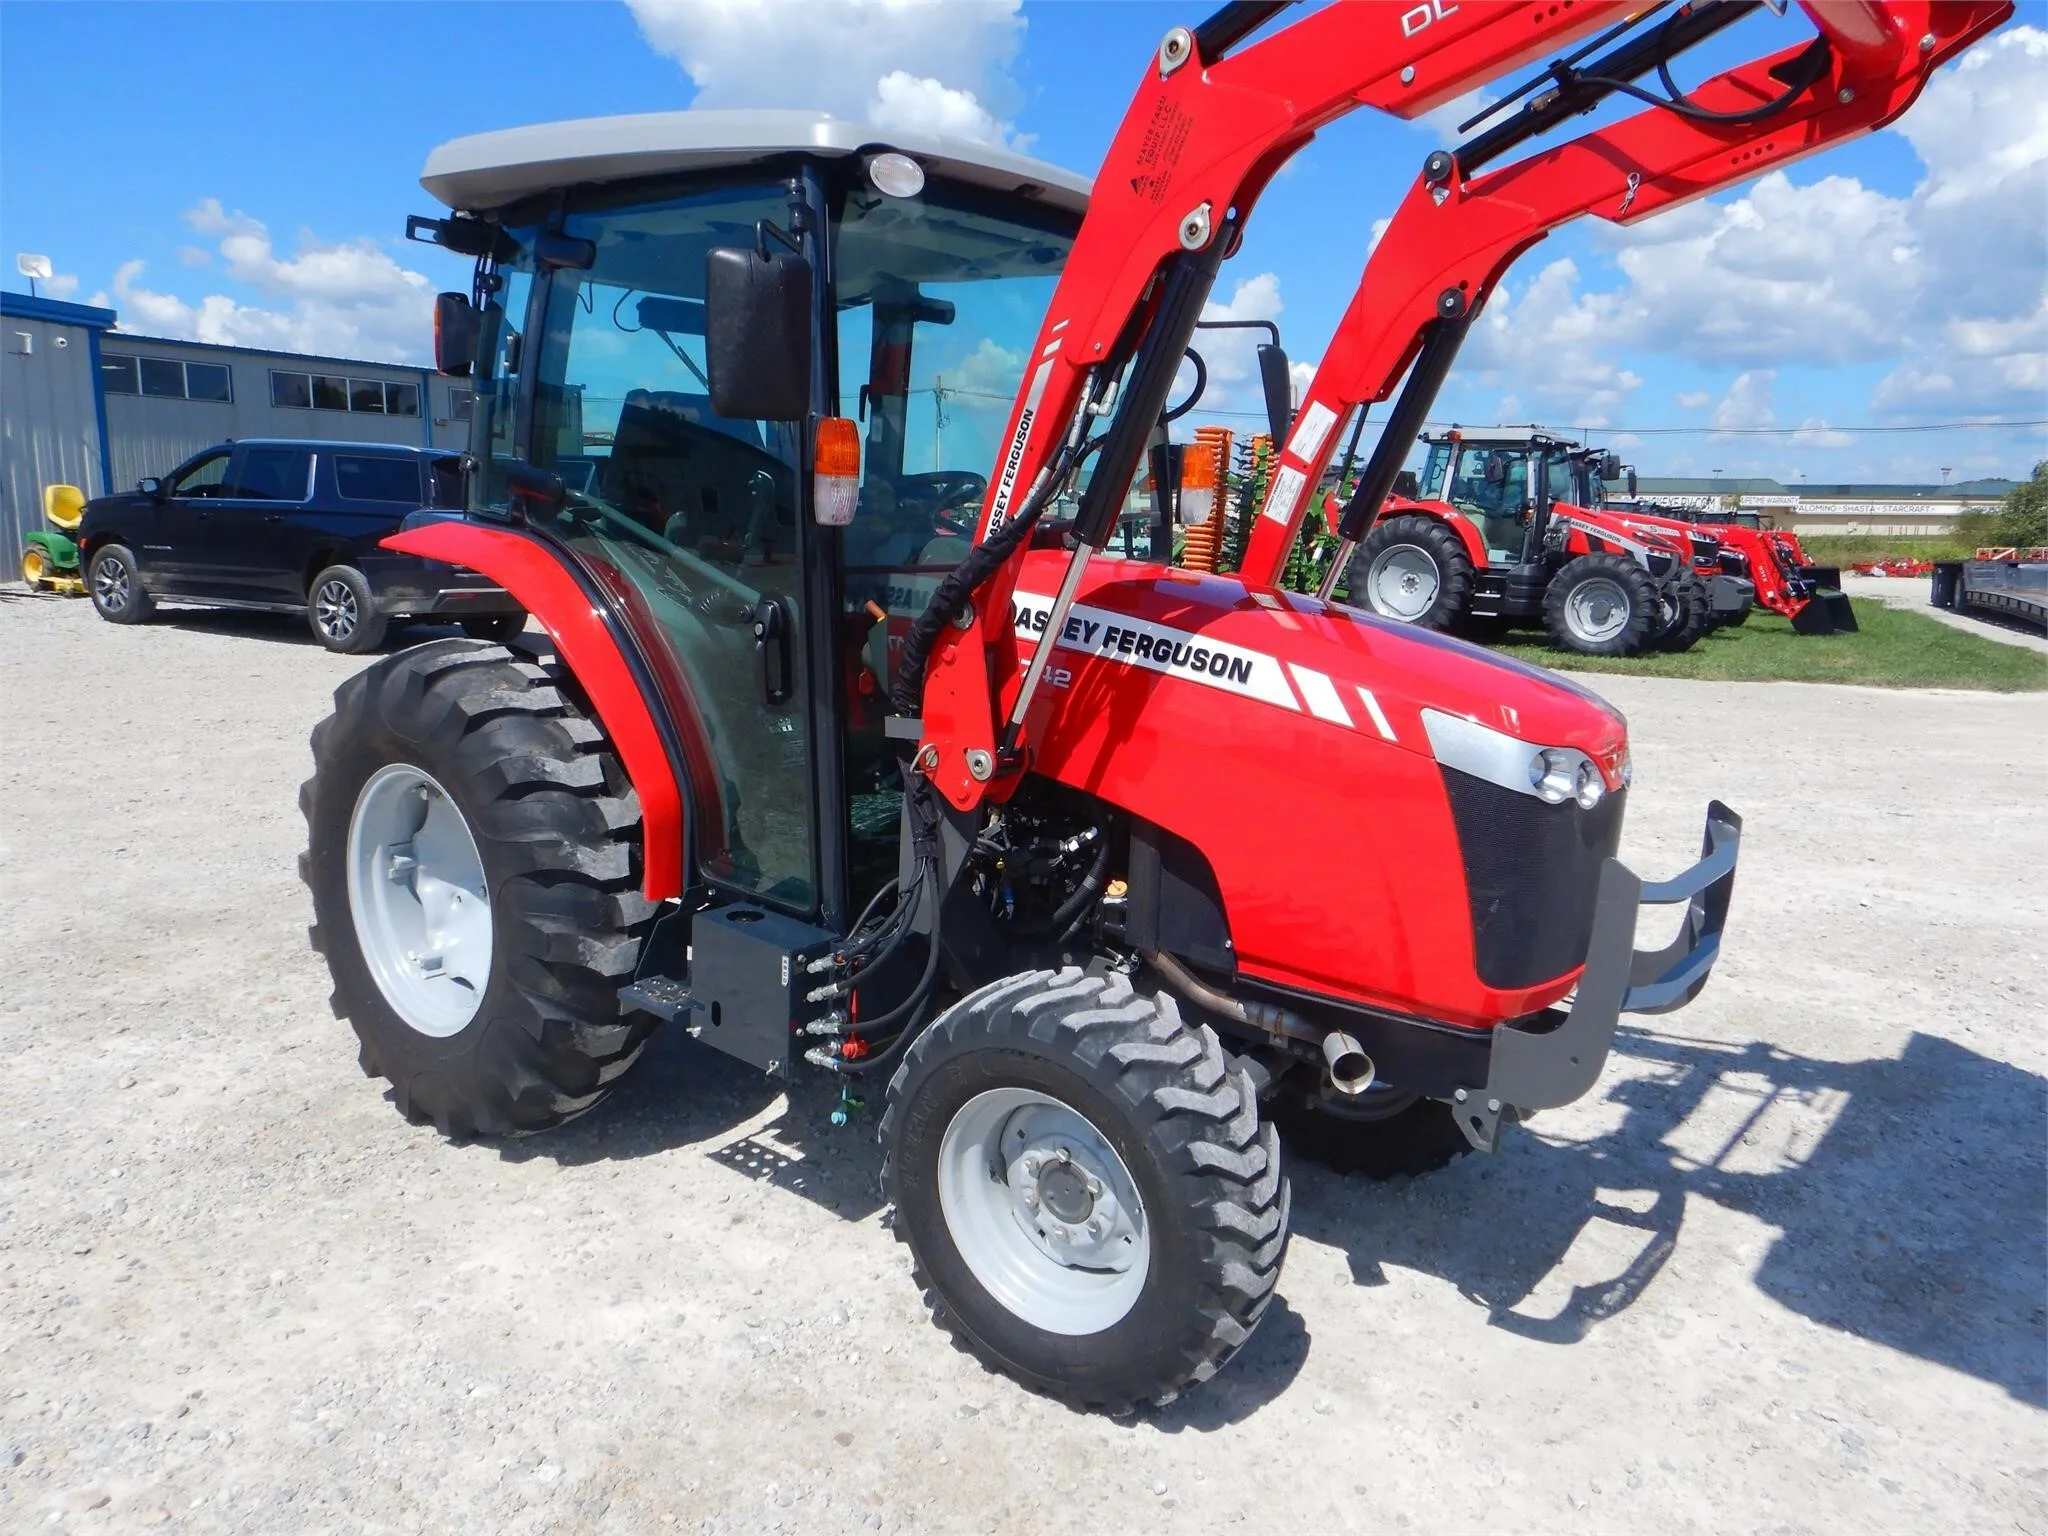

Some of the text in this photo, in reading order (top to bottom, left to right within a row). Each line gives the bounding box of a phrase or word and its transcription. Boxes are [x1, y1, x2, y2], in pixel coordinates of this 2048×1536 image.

[989, 409, 1034, 537] ASSEY FERGUSON
[1571, 520, 1588, 530] ASSEY
[1792, 504, 1931, 513] PALOMINO SHASTA STARCRAFT
[1011, 606, 1254, 685] ASEY FERGUSON
